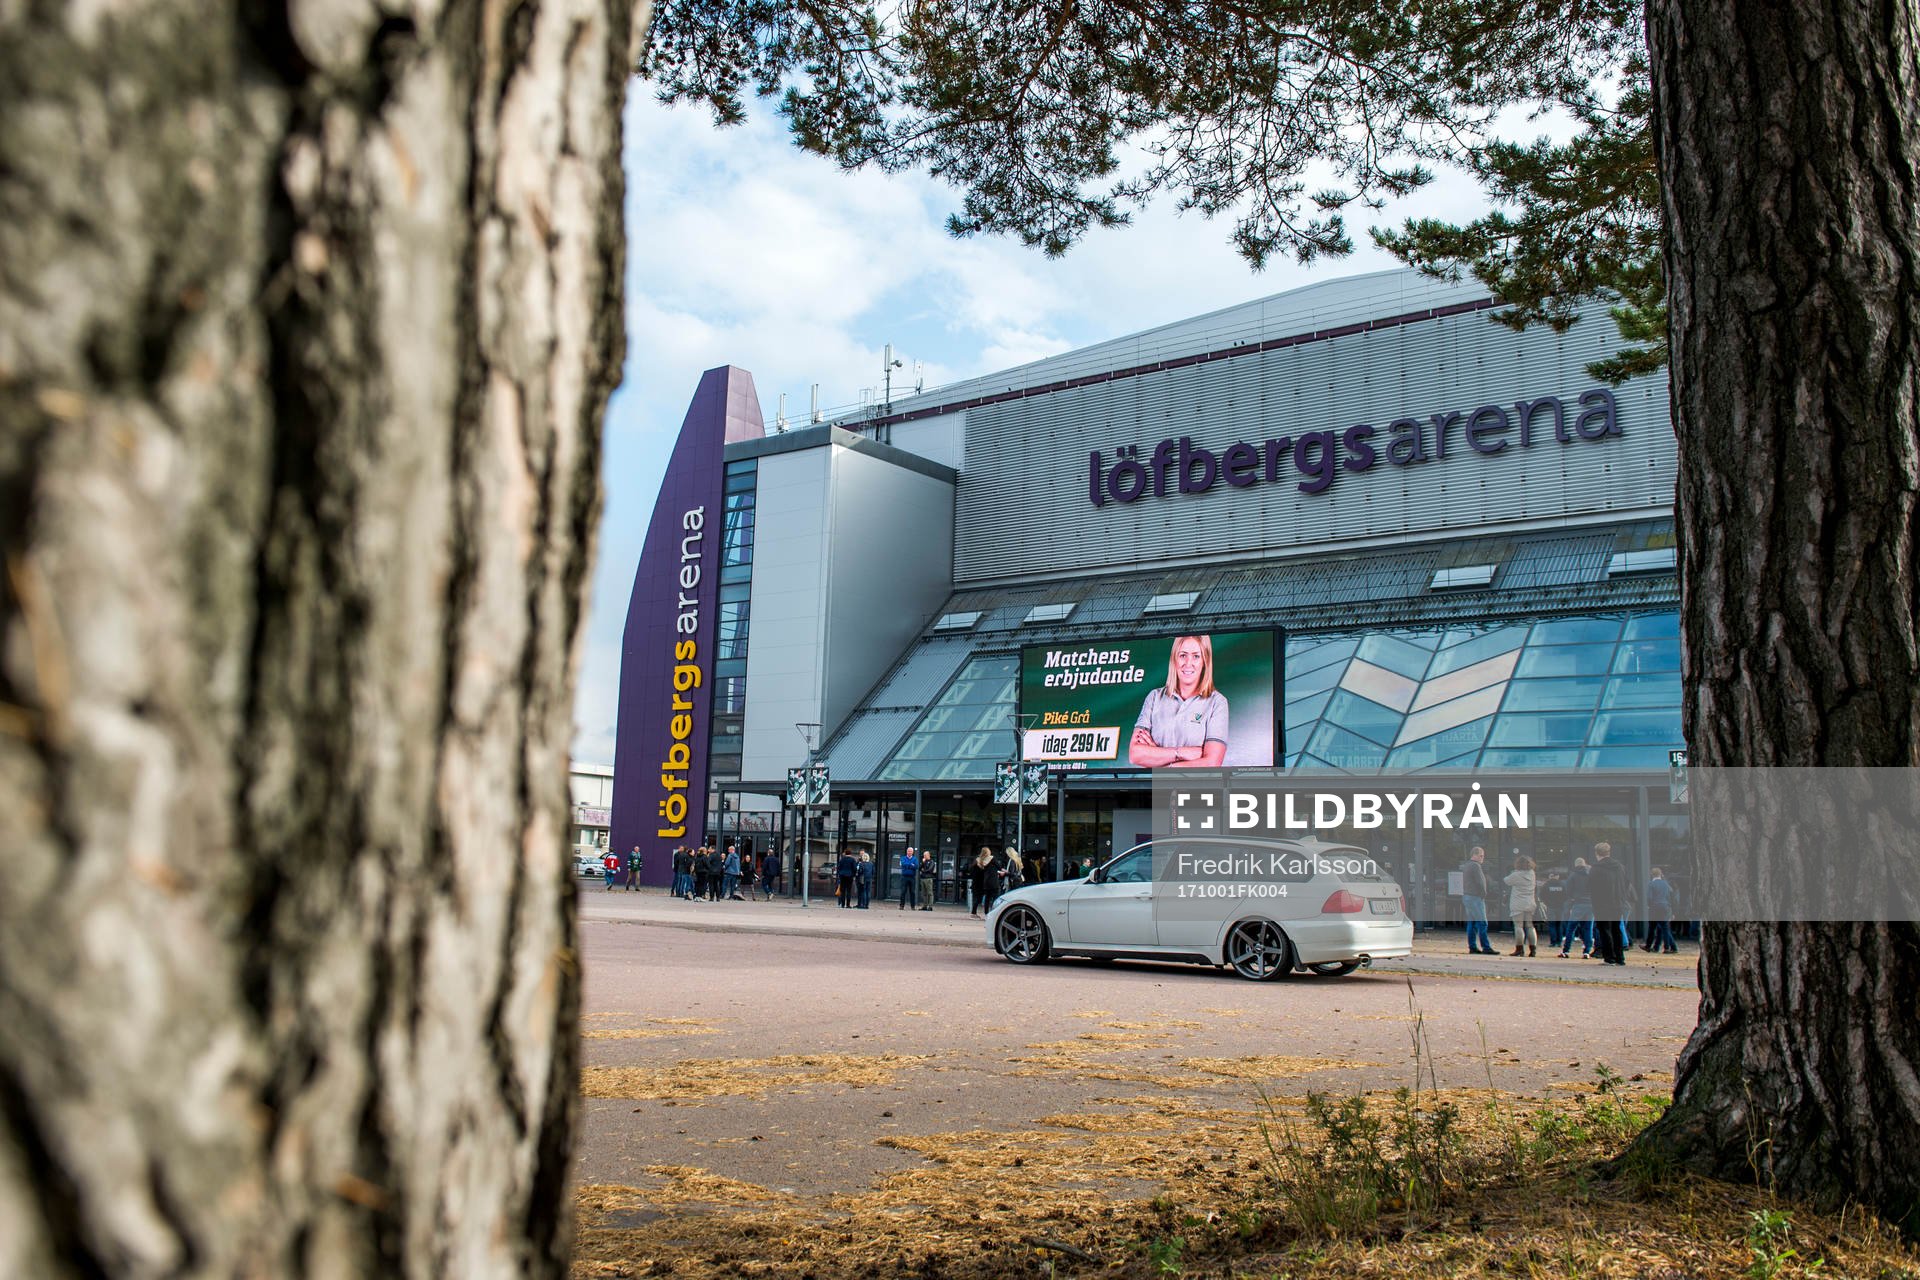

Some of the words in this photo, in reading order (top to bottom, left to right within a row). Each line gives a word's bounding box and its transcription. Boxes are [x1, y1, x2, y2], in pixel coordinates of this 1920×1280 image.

[1089, 387, 1623, 506] löfbergsarena
[1044, 648, 1130, 668] Matchens
[658, 505, 705, 838] löfbergsarena
[1044, 665, 1145, 690] erbjudande
[1043, 710, 1069, 725] Piké
[1070, 709, 1090, 724] Grå
[1042, 735, 1068, 756] idag
[1070, 733, 1094, 752] 299
[1096, 733, 1110, 752] kr
[1672, 752, 1683, 762] 16
